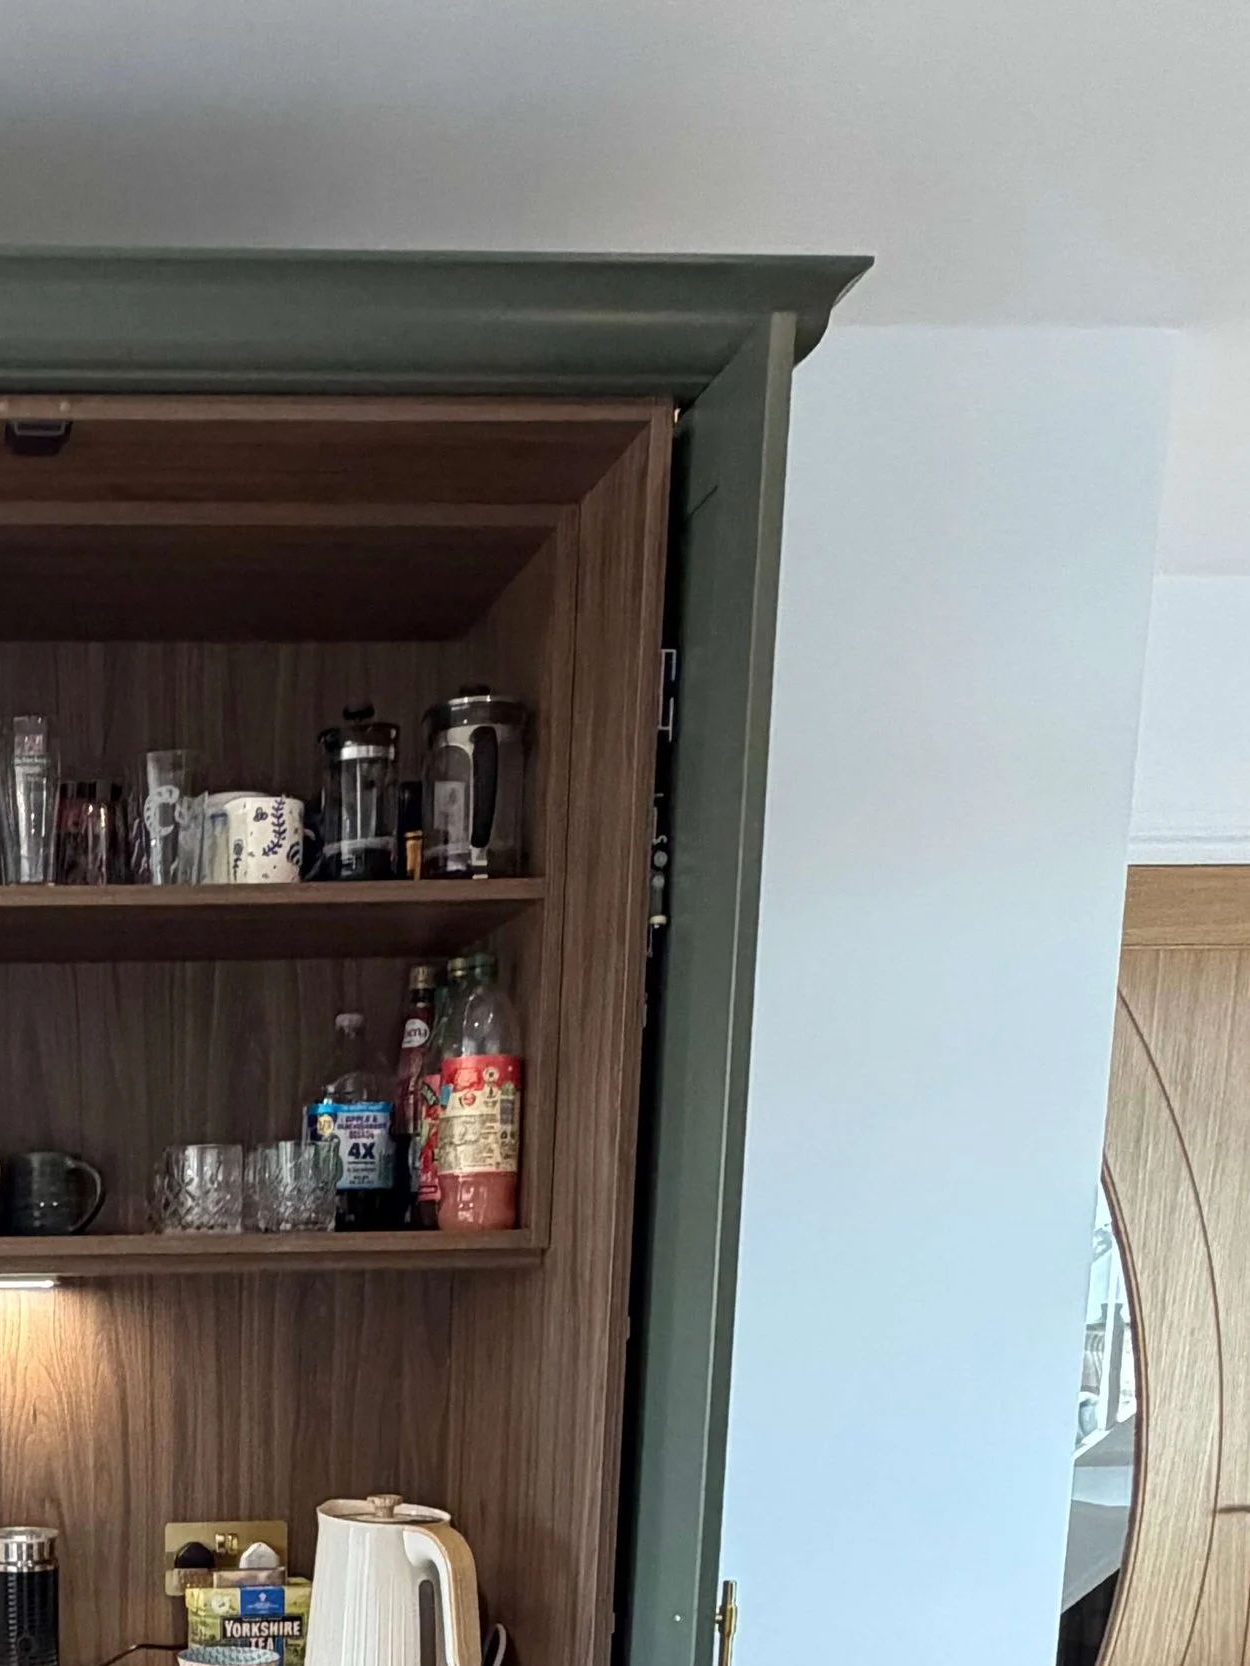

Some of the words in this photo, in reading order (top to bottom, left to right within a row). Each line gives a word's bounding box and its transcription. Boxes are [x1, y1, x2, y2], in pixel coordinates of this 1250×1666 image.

[347, 1142, 376, 1160] 4X
[224, 1620, 301, 1637] YORKSHIRE
[250, 1637, 275, 1650] TEA
